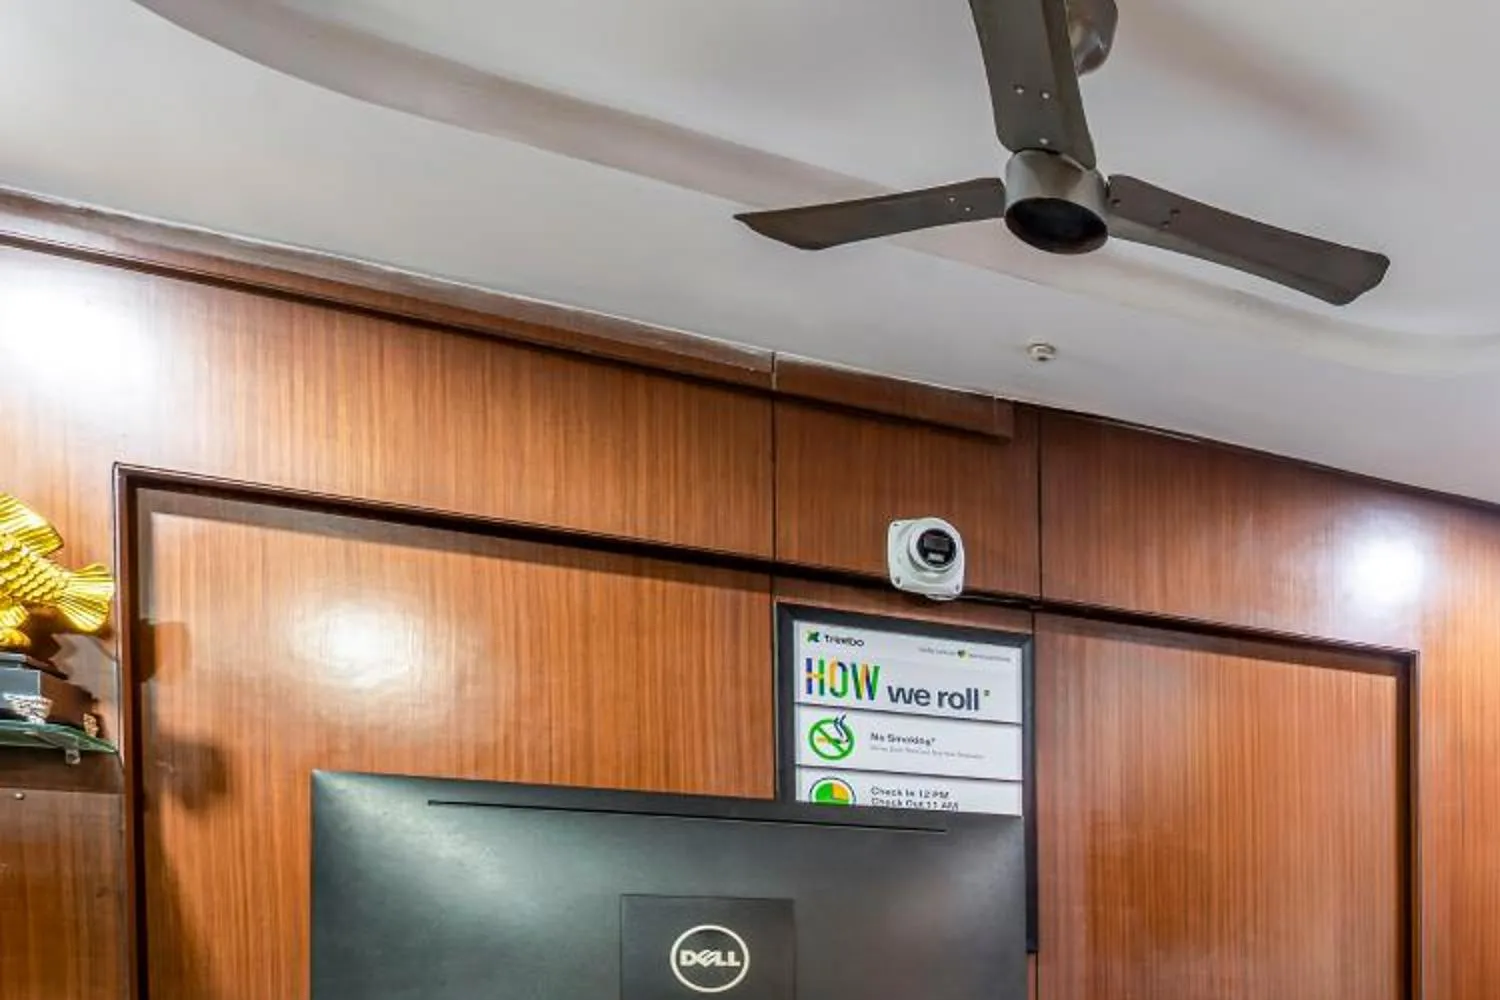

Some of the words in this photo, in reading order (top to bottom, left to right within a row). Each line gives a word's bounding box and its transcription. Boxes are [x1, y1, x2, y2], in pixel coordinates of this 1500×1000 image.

[824, 633, 865, 647] treebo
[805, 657, 880, 701] HOW
[887, 685, 930, 707] we
[870, 732, 885, 742] No
[680, 949, 741, 967] DELL
